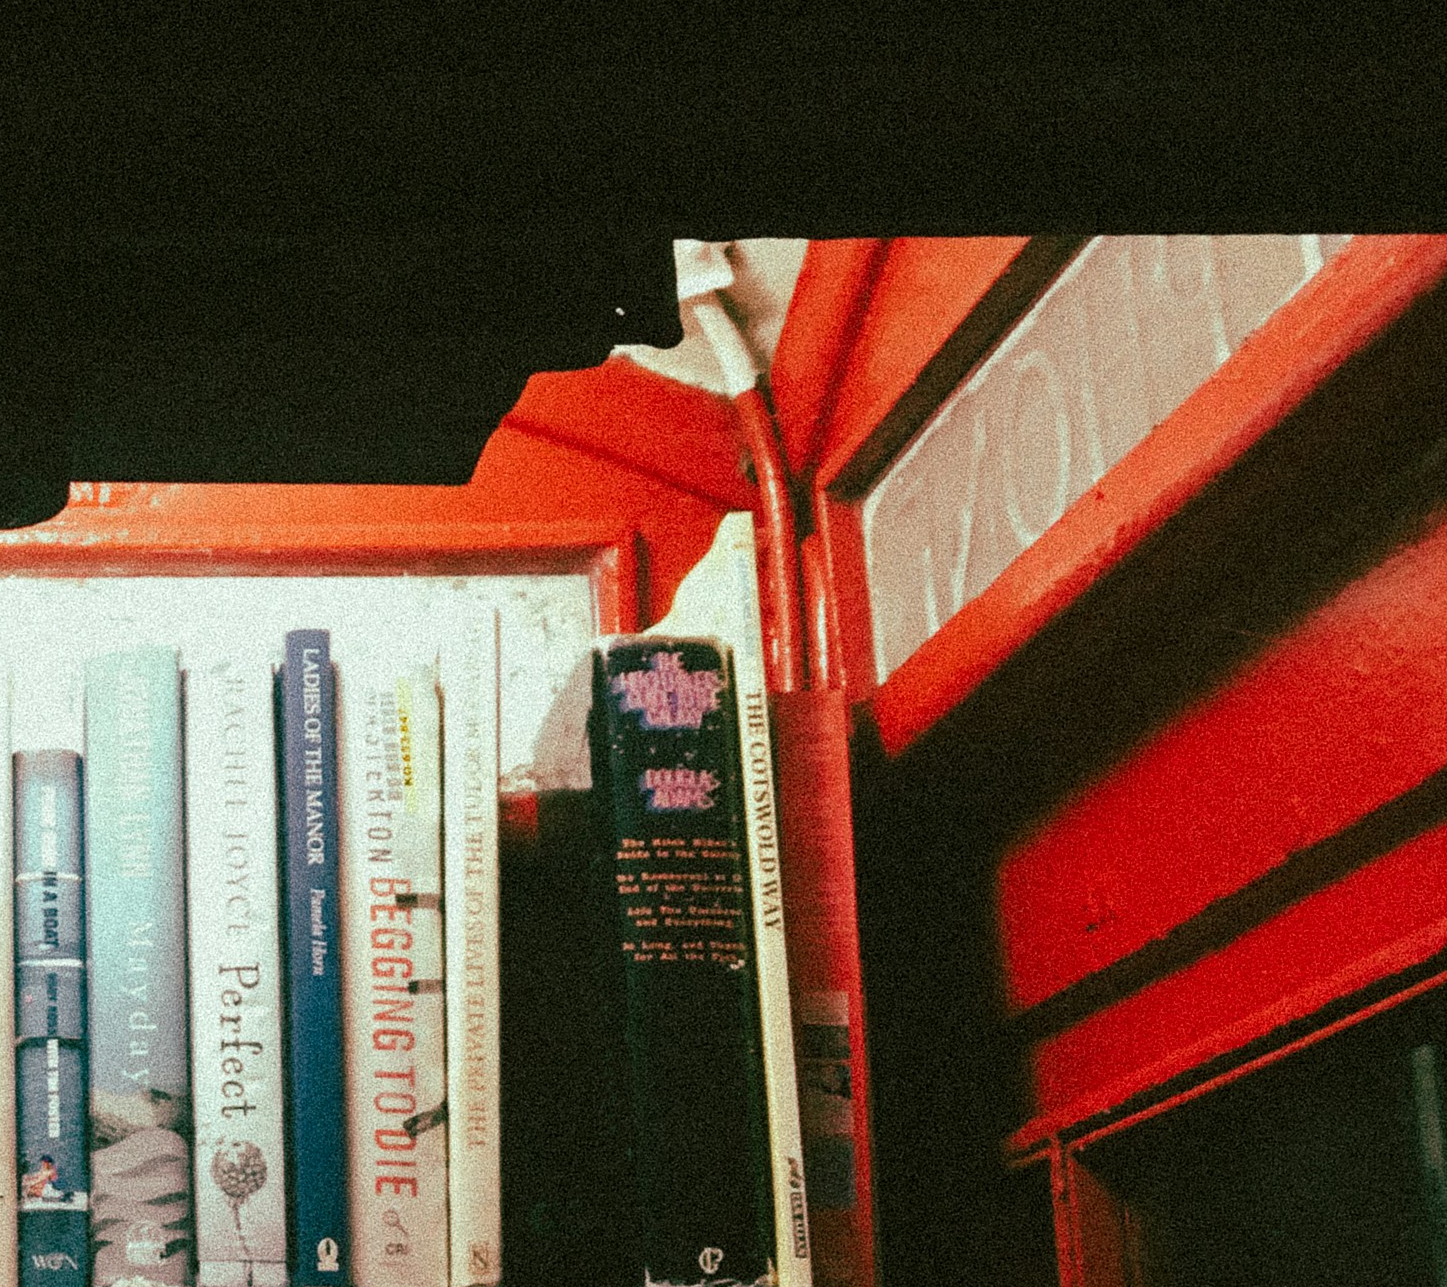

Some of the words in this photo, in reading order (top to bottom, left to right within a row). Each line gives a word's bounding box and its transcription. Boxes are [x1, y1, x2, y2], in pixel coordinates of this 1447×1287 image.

[303, 648, 323, 714] LADIES
[222, 673, 252, 809] RACHEL
[304, 716, 324, 739] OF
[746, 688, 766, 737] THE
[305, 741, 325, 784] THE
[306, 787, 328, 866] MANOR
[748, 741, 779, 876] COTSWOLD
[223, 826, 254, 937] JOYCE
[463, 831, 486, 880] THE
[42, 890, 59, 903] A
[309, 888, 328, 936] Pamela
[463, 886, 487, 916] OF
[760, 880, 783, 931] WAY
[42, 906, 59, 949] BOAT
[463, 918, 487, 988] LIVES
[368, 876, 414, 1051] BEGGING
[121, 919, 158, 1088] Mayday
[219, 962, 264, 1119] Perfect
[463, 993, 487, 1092] PRIVATE
[372, 1066, 414, 1111] TO
[463, 1102, 487, 1149] THE
[374, 1129, 419, 1197] DIE
